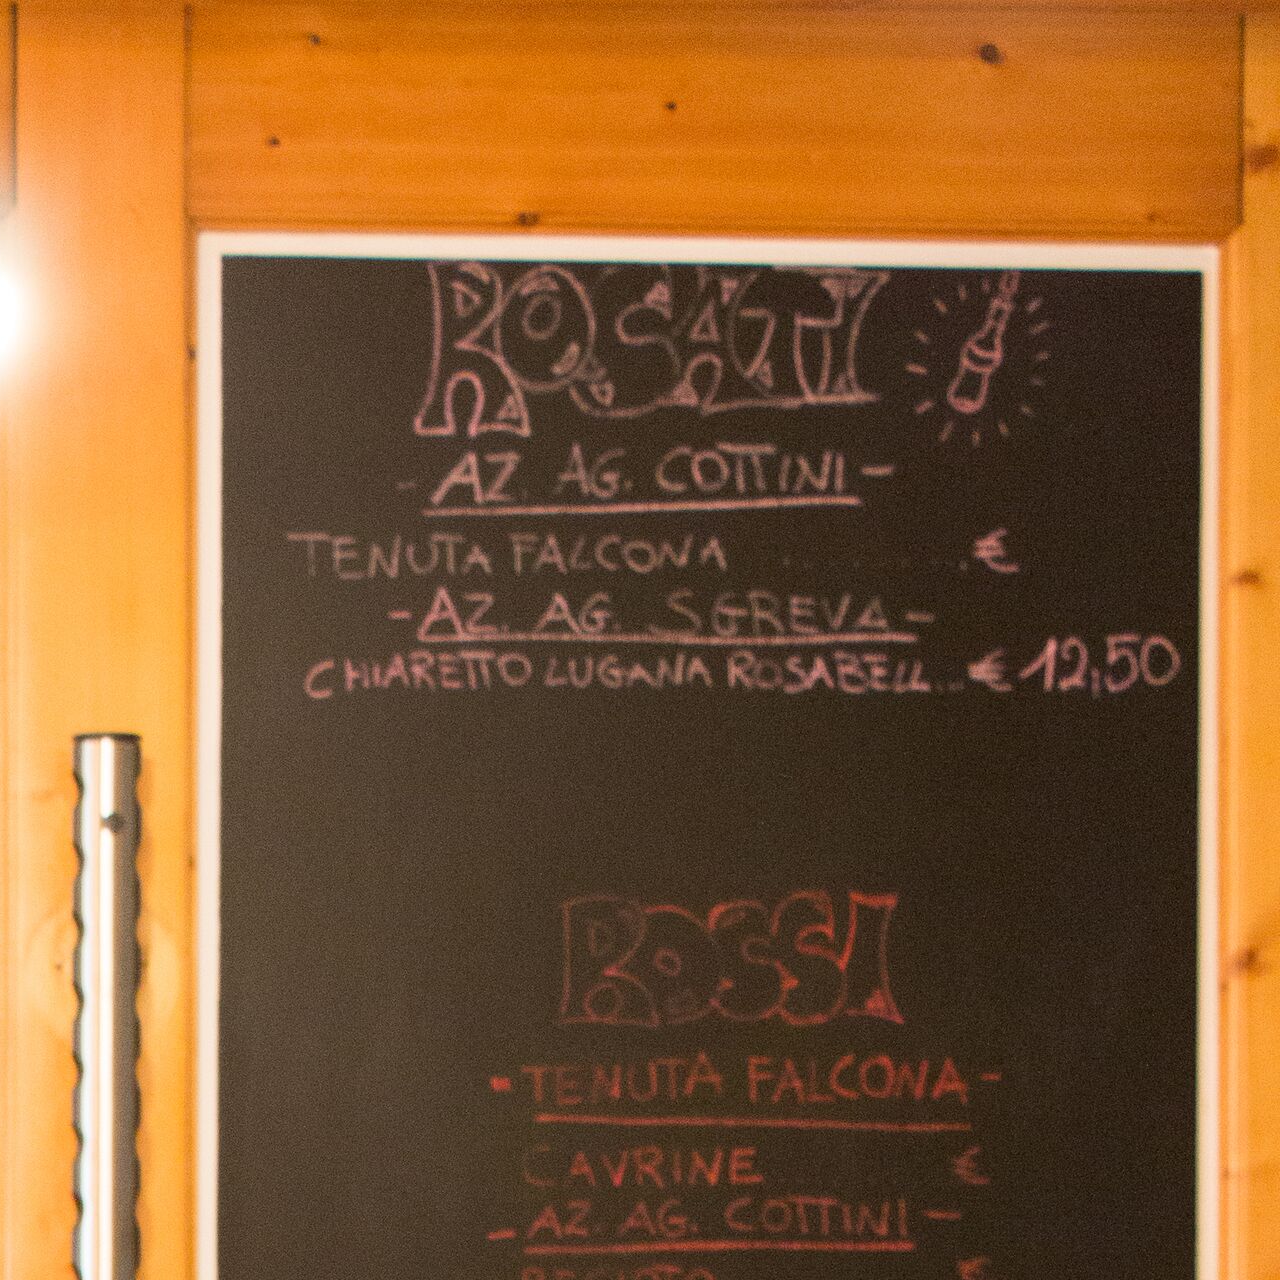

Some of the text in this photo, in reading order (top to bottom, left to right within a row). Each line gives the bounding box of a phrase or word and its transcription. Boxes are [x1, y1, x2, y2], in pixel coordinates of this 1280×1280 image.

[655, 442, 845, 494] COTTINI
[286, 527, 1020, 580] TENUTA FALCONA €
[304, 649, 532, 699] CHIARETTO
[544, 652, 713, 691] LUGANA
[1020, 633, 1181, 698] 12,50
[558, 890, 904, 1027] ROSSI
[520, 1050, 969, 1104] TENUTA FALCONA
[722, 1194, 909, 1238] COTTINI
